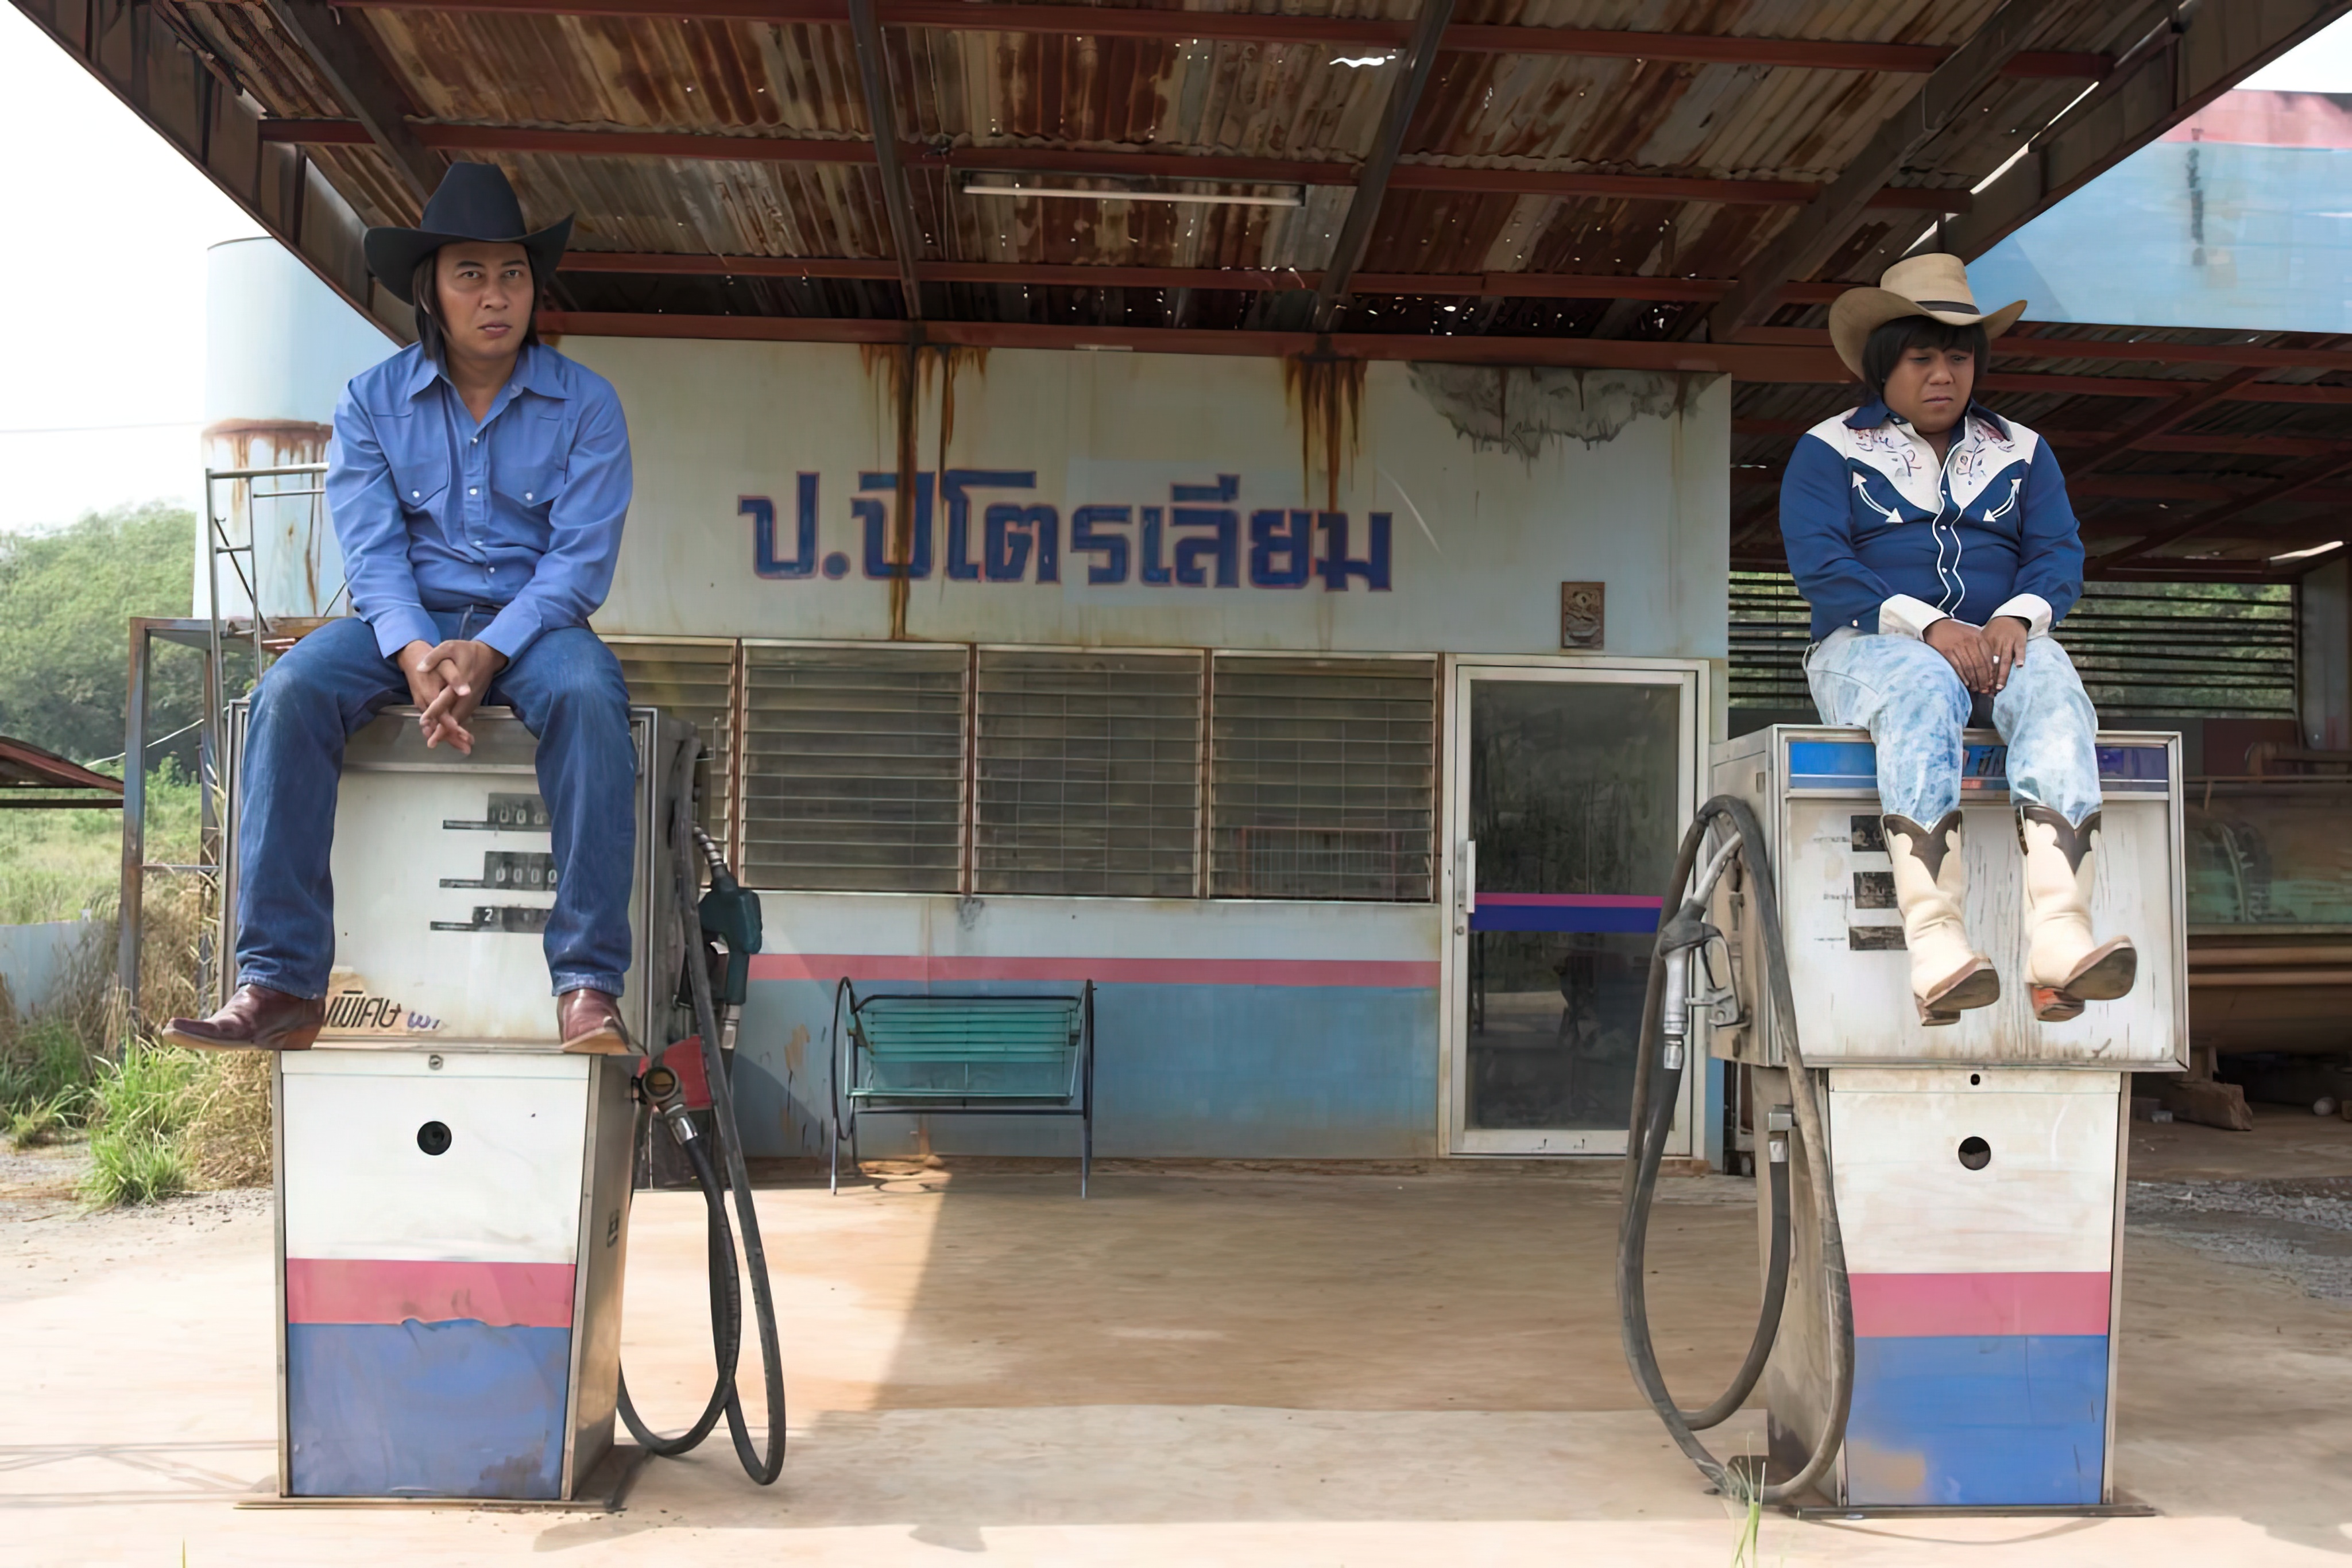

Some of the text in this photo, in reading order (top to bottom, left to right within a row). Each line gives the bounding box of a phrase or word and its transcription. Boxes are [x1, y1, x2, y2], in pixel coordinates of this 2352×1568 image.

[738, 469, 1393, 592] ป.ปิโตรเลียม
